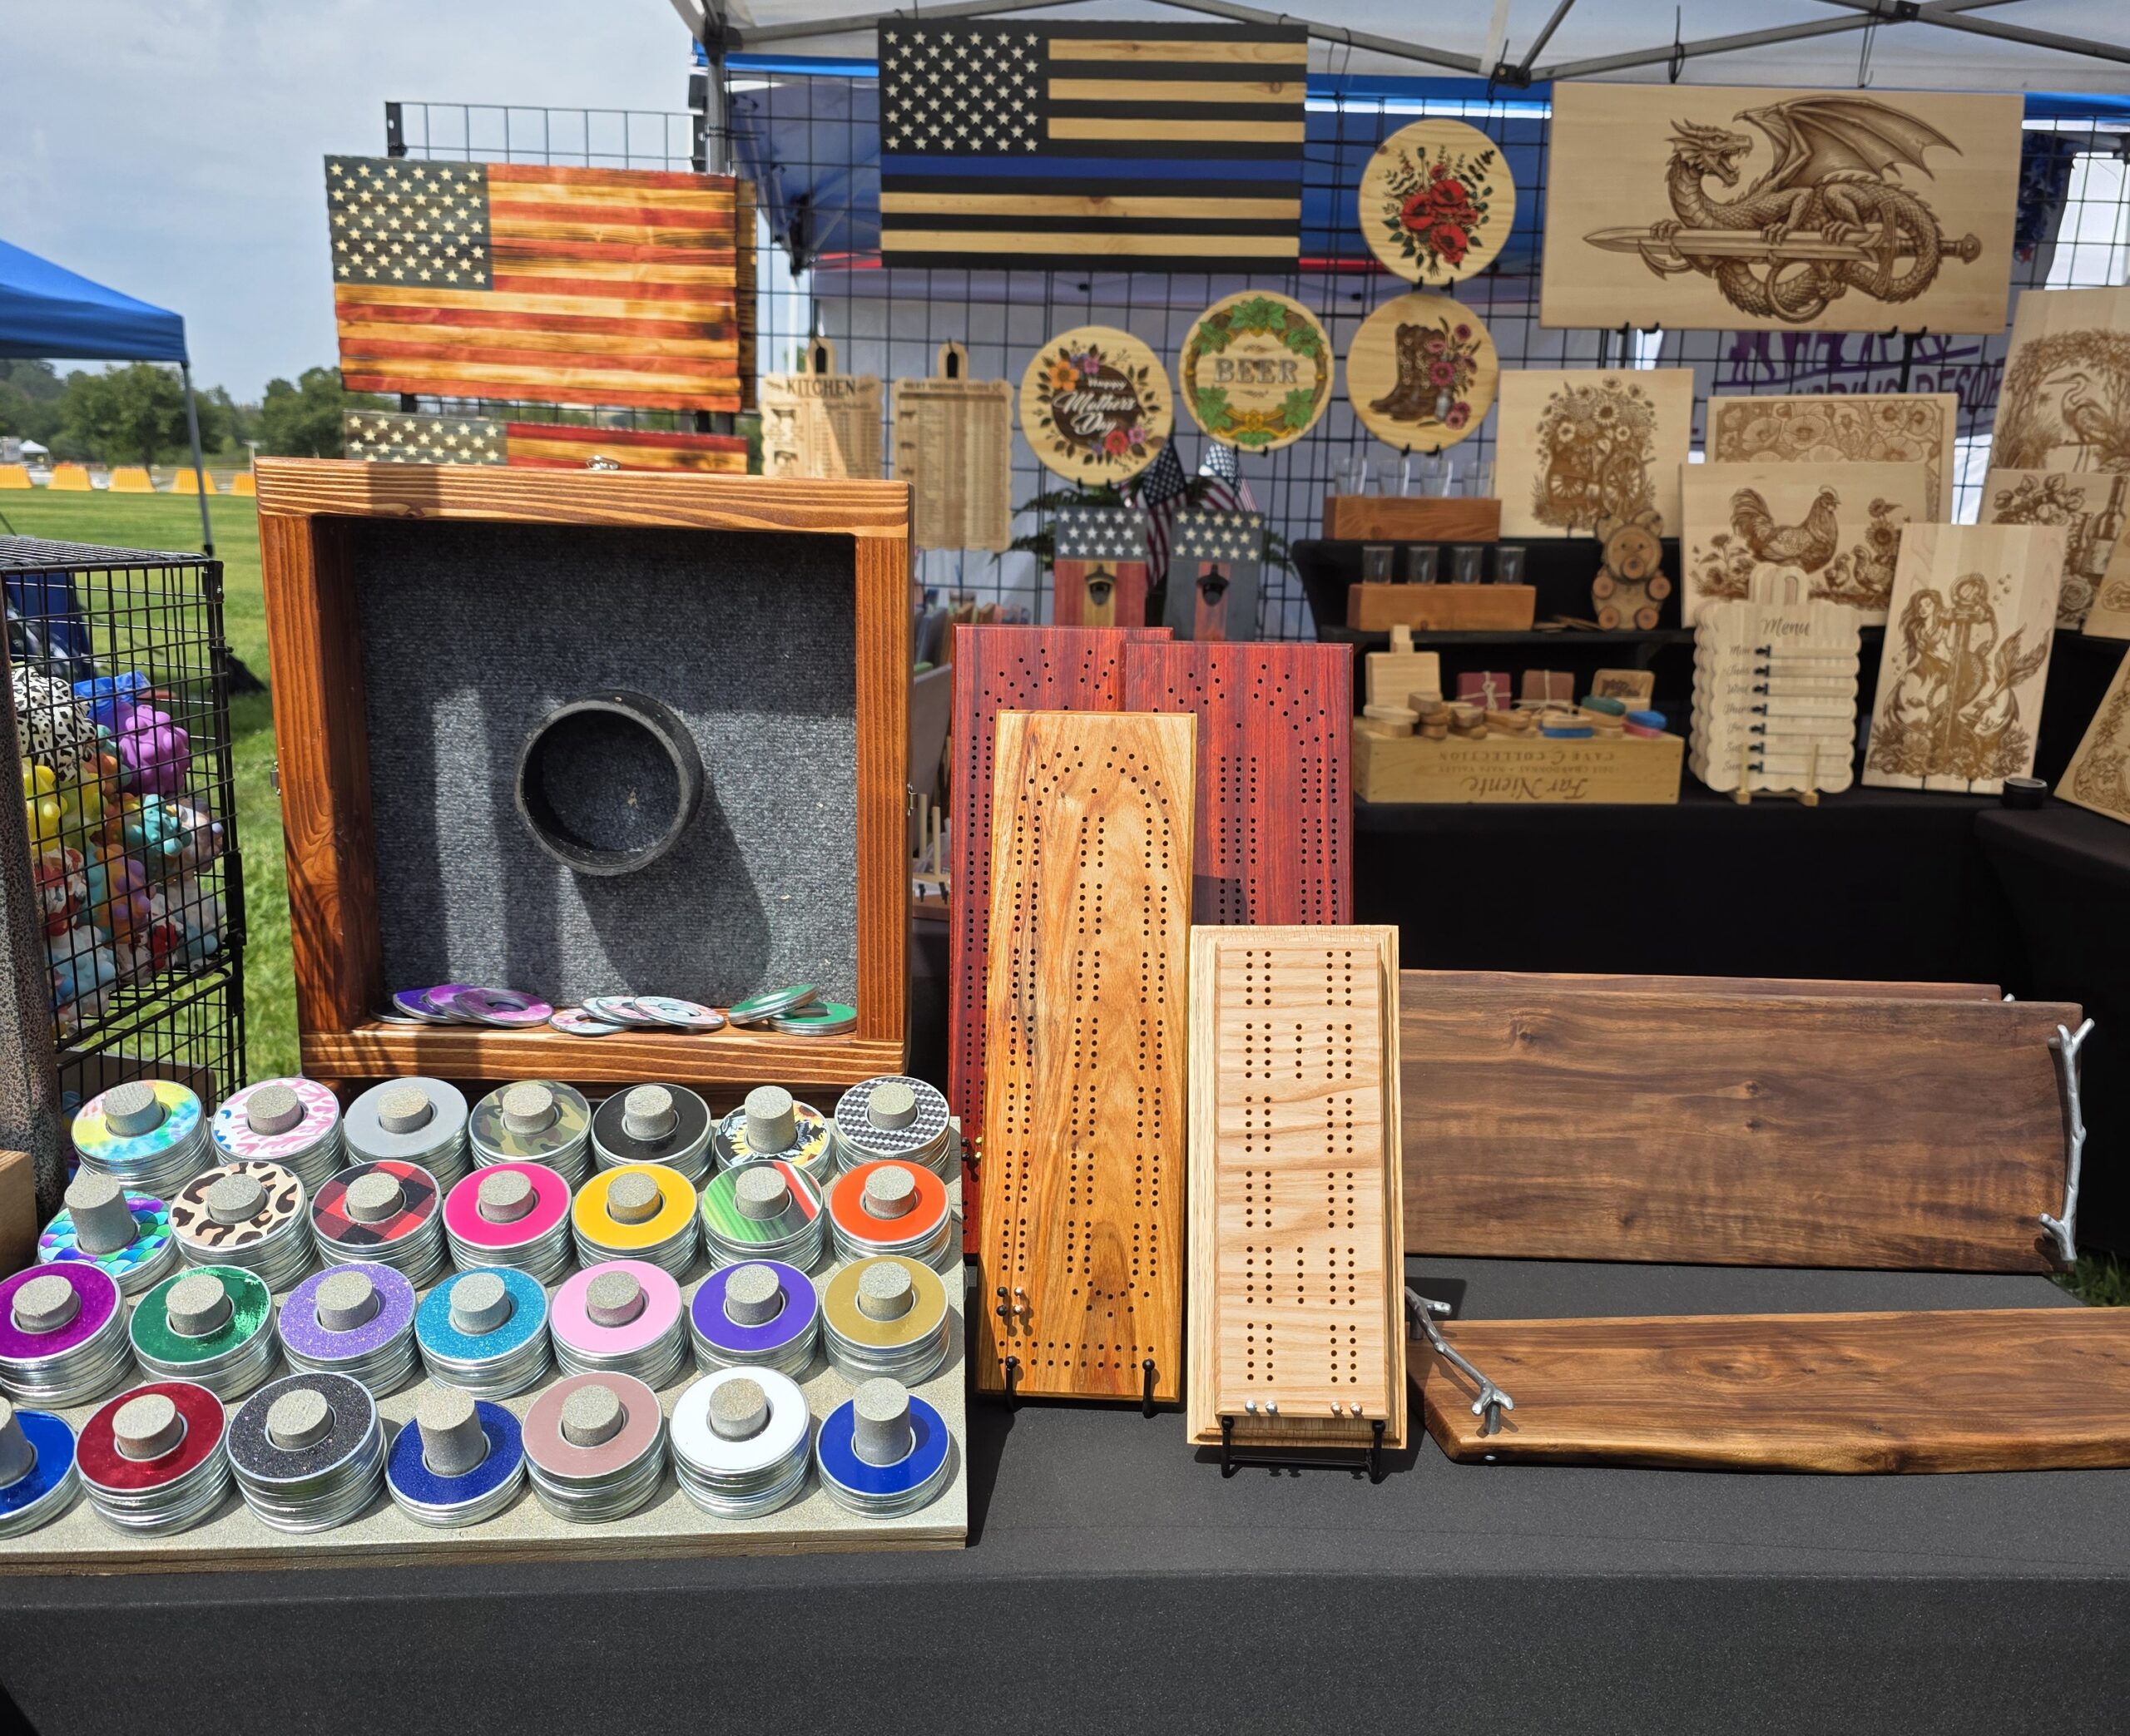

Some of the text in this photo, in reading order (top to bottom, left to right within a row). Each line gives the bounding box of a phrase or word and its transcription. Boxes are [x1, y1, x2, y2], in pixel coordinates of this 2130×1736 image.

[1214, 358, 1299, 384] BEER
[785, 378, 856, 398] KITCHEN
[1087, 377, 1127, 391] Happy
[1069, 413, 1117, 438] Day
[1761, 617, 1811, 637] Menu
[1439, 751, 1545, 762] COLLECTION
[1571, 752, 1615, 762] CAVE
[1459, 777, 1590, 800] Far Niente
